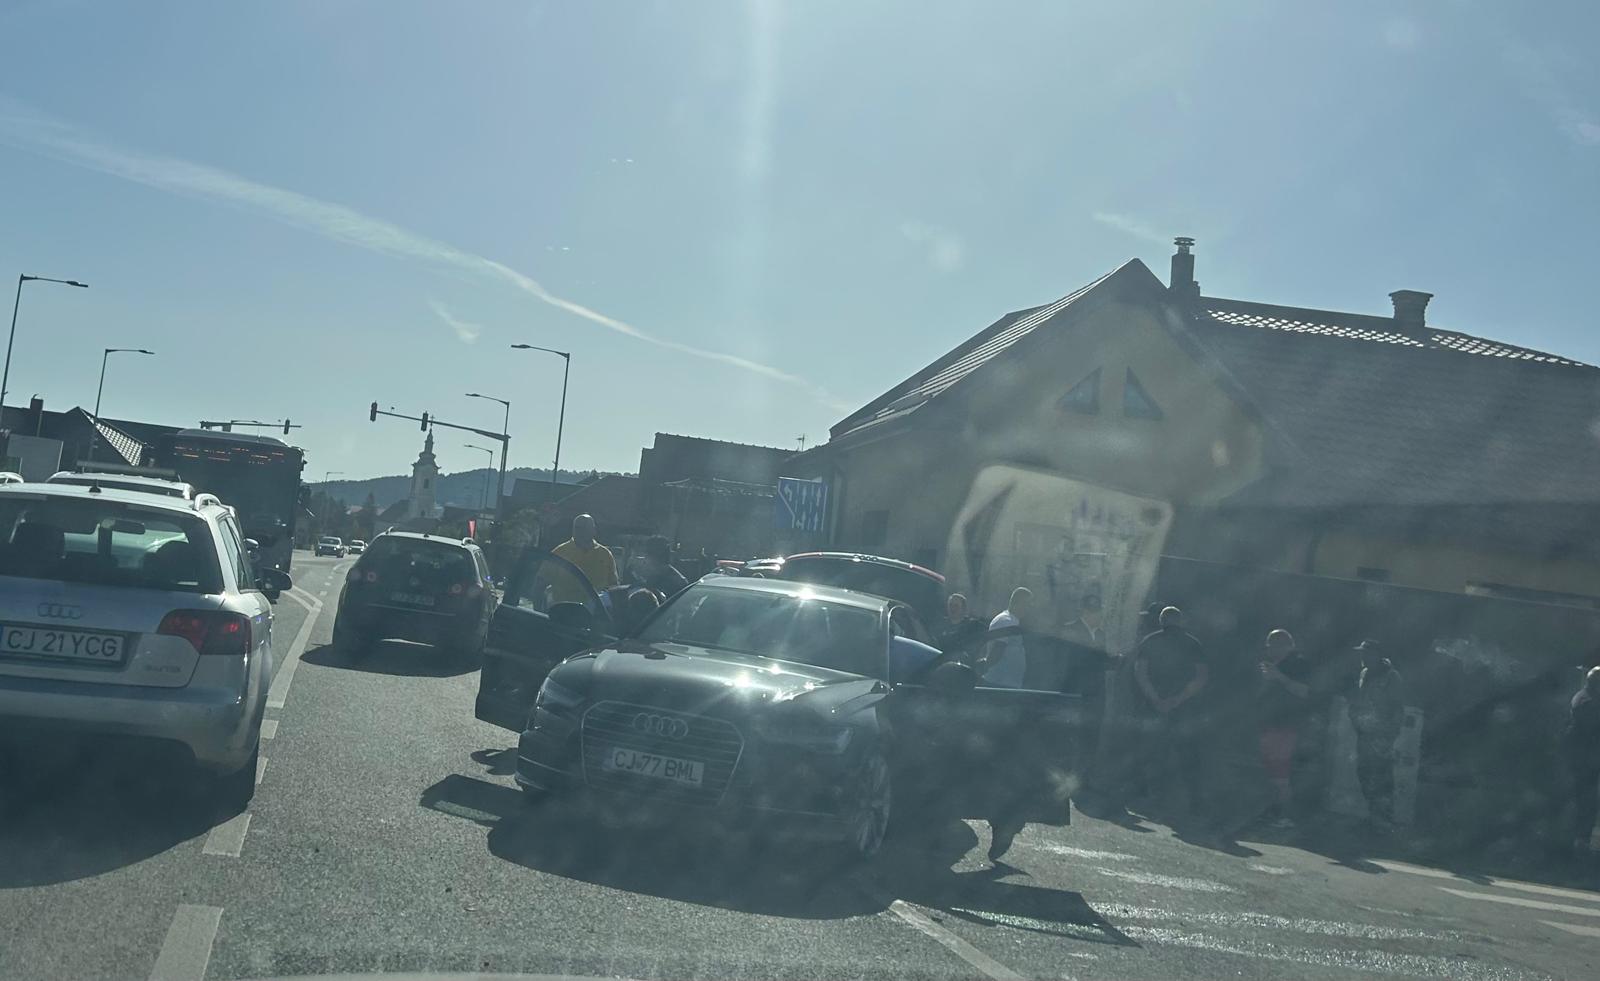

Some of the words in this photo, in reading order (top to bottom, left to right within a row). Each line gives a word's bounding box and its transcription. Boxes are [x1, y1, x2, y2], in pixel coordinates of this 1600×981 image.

[7, 630, 35, 650] CJ
[42, 632, 65, 653] 21
[72, 635, 118, 657] YCG
[614, 751, 636, 770] CJ
[640, 755, 662, 774] 77
[664, 759, 698, 782] BML
